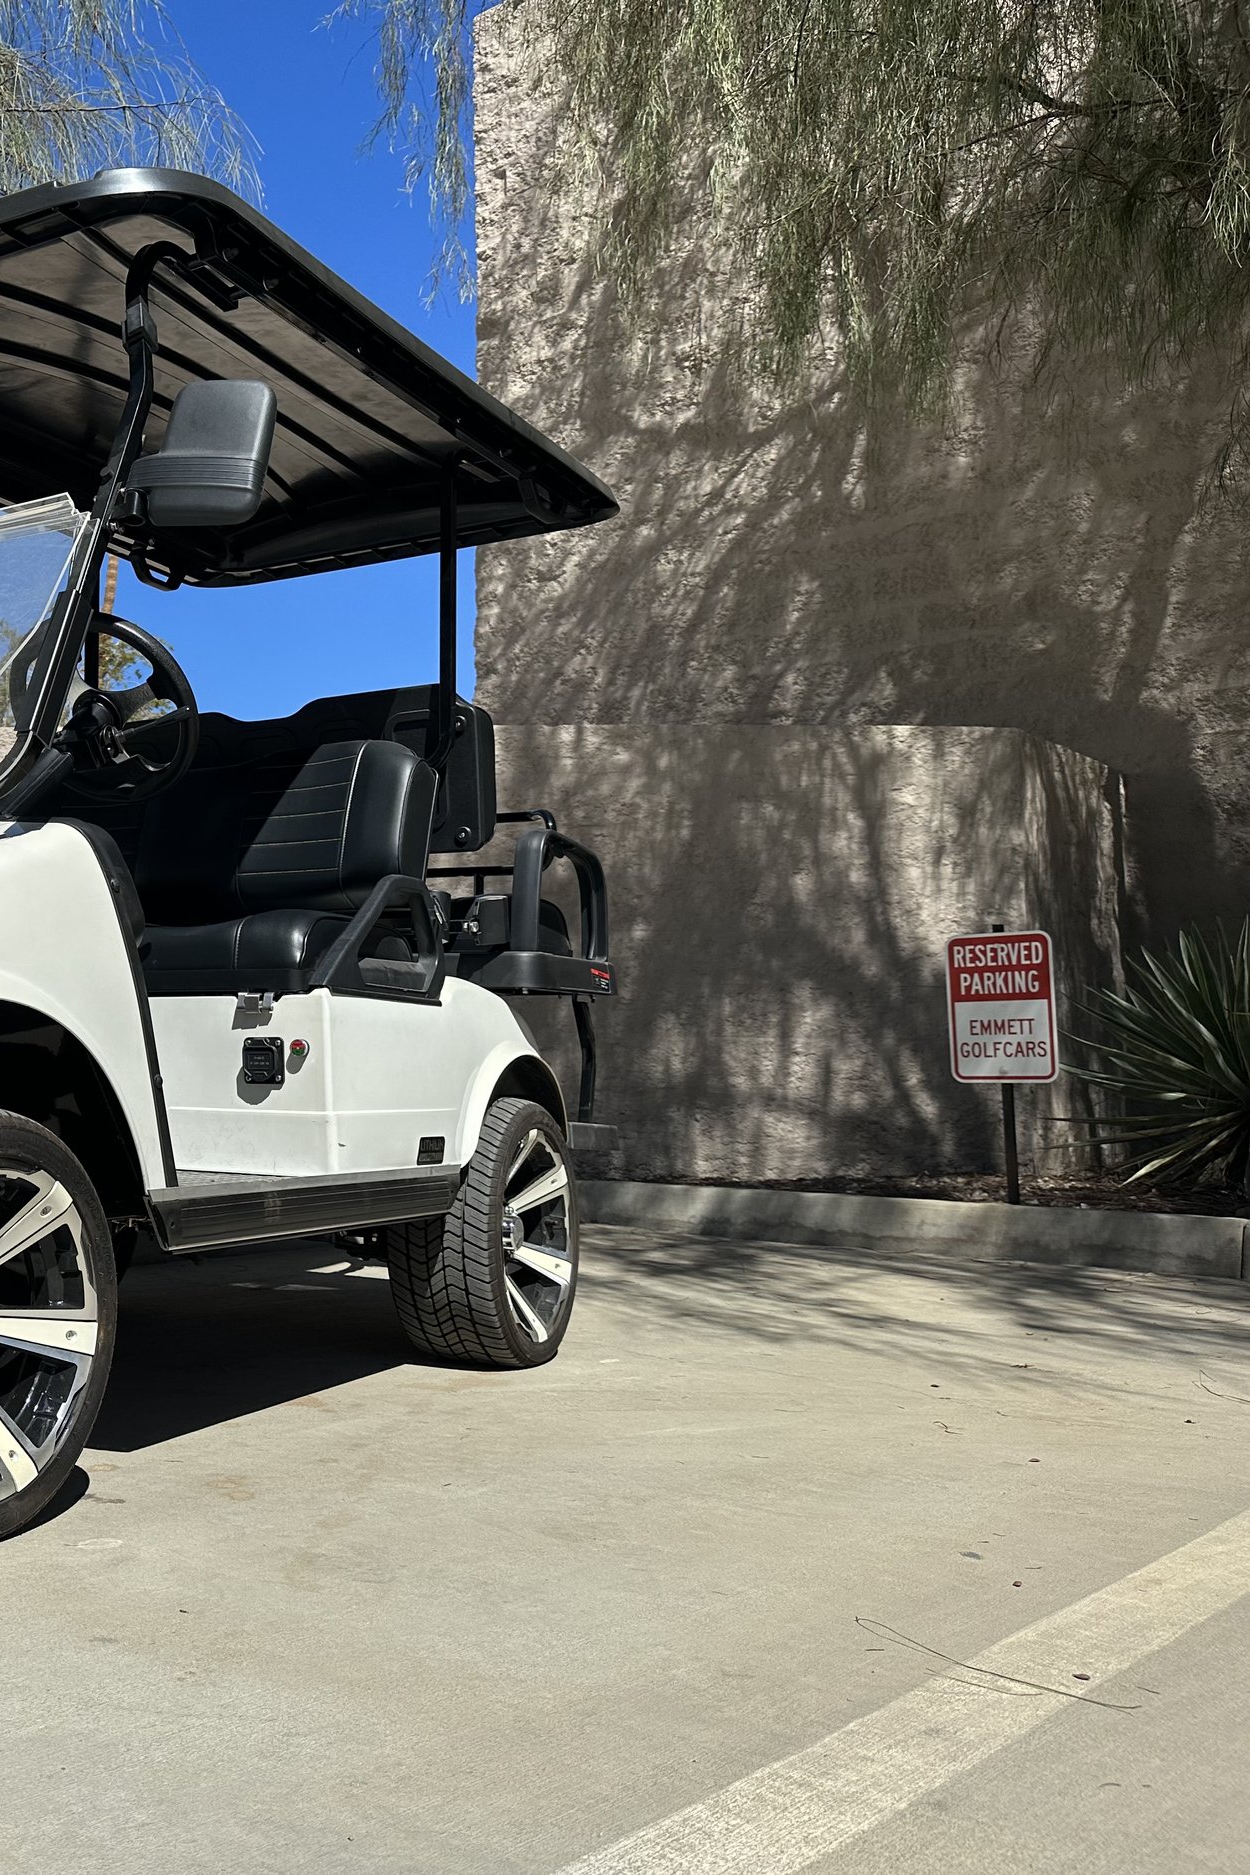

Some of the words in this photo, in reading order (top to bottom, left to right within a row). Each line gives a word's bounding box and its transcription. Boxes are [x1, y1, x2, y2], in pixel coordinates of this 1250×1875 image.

[954, 942, 1043, 968] RESERVED
[960, 970, 1039, 995] PARKING
[969, 1018, 1035, 1036] EMMETT
[960, 1041, 1047, 1058] GOLFCARS
